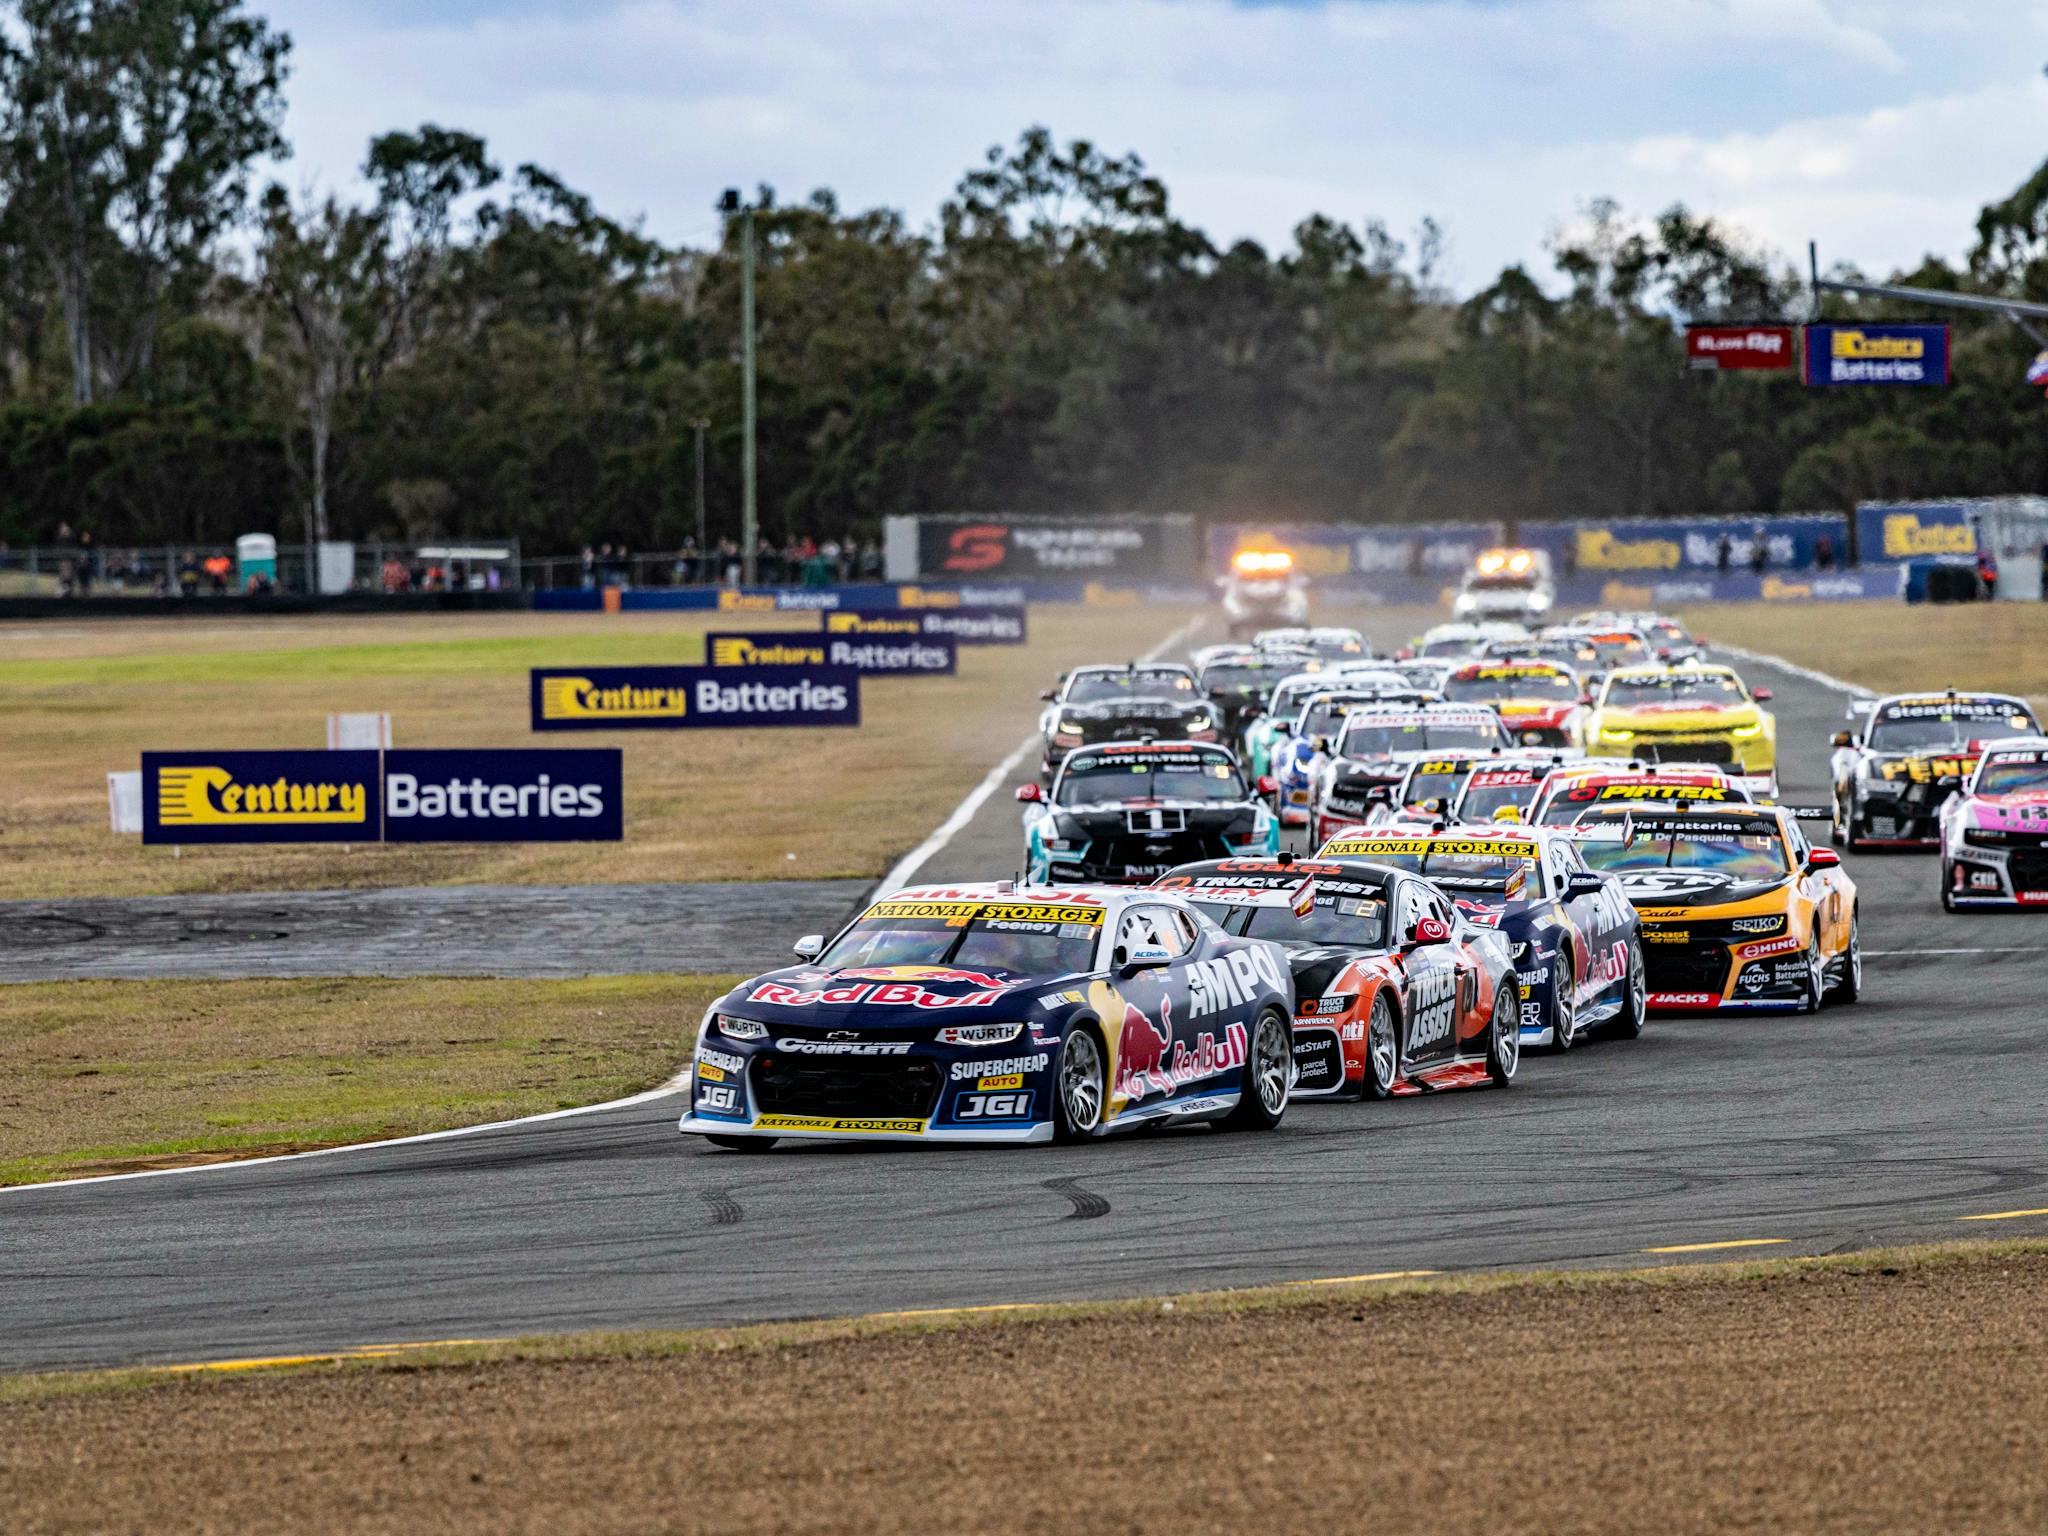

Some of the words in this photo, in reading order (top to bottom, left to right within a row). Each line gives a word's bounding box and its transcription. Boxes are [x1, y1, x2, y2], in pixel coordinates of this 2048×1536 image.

[1831, 358, 1924, 382] Batteries
[923, 614, 1022, 637] Batteries
[831, 641, 949, 668] Batteries
[541, 676, 687, 720] Century
[696, 680, 849, 714] Batteries
[158, 766, 367, 826] Century
[386, 773, 604, 819] Batteries
[1601, 786, 1728, 801] PIRTEK
[1663, 822, 1742, 831] Batteries
[1675, 833, 1735, 843] Pasquale
[1326, 841, 1423, 854] NATIONAL
[1433, 842, 1532, 856] STORAGE
[1217, 861, 1344, 876] Coates
[1195, 876, 1285, 889] TRUCK
[872, 906, 974, 918] NATIONAL
[984, 906, 1097, 922] STORAGE
[1638, 909, 1690, 917] Cadet
[986, 919, 1057, 933] Feeney
[1732, 916, 1778, 932] SEIKO
[1760, 939, 1798, 953] HINO
[1775, 961, 1808, 970] Industrial
[1739, 973, 1770, 984] FUCHS
[1775, 970, 1808, 980] Batteries
[746, 982, 874, 1006] Red
[864, 983, 1012, 1009] Bull
[1414, 966, 1456, 1010] TRUCK
[1316, 1005, 1343, 1014] ASSIST
[1319, 998, 1345, 1006] TRUCK
[728, 1019, 762, 1034] WÜRTH
[961, 1028, 1014, 1040] WÜRTH
[1341, 1020, 1365, 1039] nti
[1408, 1003, 1455, 1051] ASSIST
[1202, 1021, 1248, 1077] Bull
[950, 1053, 1049, 1080] SUPERCHEAP
[1302, 1058, 1327, 1070] parcel
[700, 1066, 721, 1078] AUTO
[1301, 1066, 1328, 1079] protect
[982, 1077, 1018, 1087] AUTO
[701, 1086, 737, 1109] JGI
[959, 1095, 1029, 1117] JGI
[758, 1118, 833, 1128] NATIONAL
[839, 1120, 918, 1131] STORAGE
